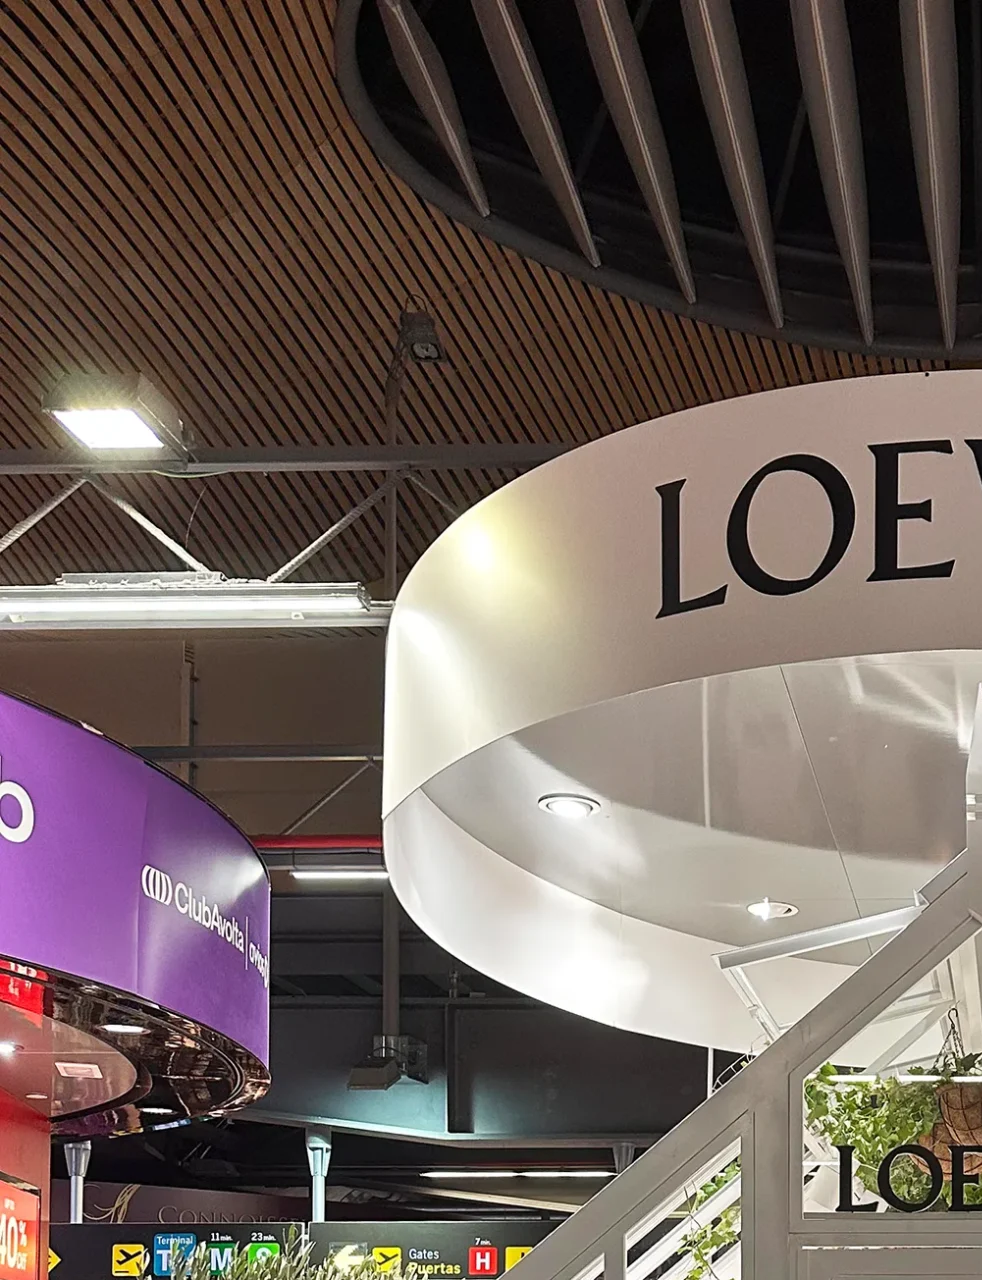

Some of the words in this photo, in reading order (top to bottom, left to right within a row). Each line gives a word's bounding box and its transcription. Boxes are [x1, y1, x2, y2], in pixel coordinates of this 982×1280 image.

[174, 882, 245, 954] ClubAvolta
[156, 1235, 193, 1246] Terminal
[211, 1247, 233, 1272] M
[408, 1248, 440, 1260] Gates
[475, 1251, 491, 1271] H
[407, 1262, 461, 1275] Puertas
